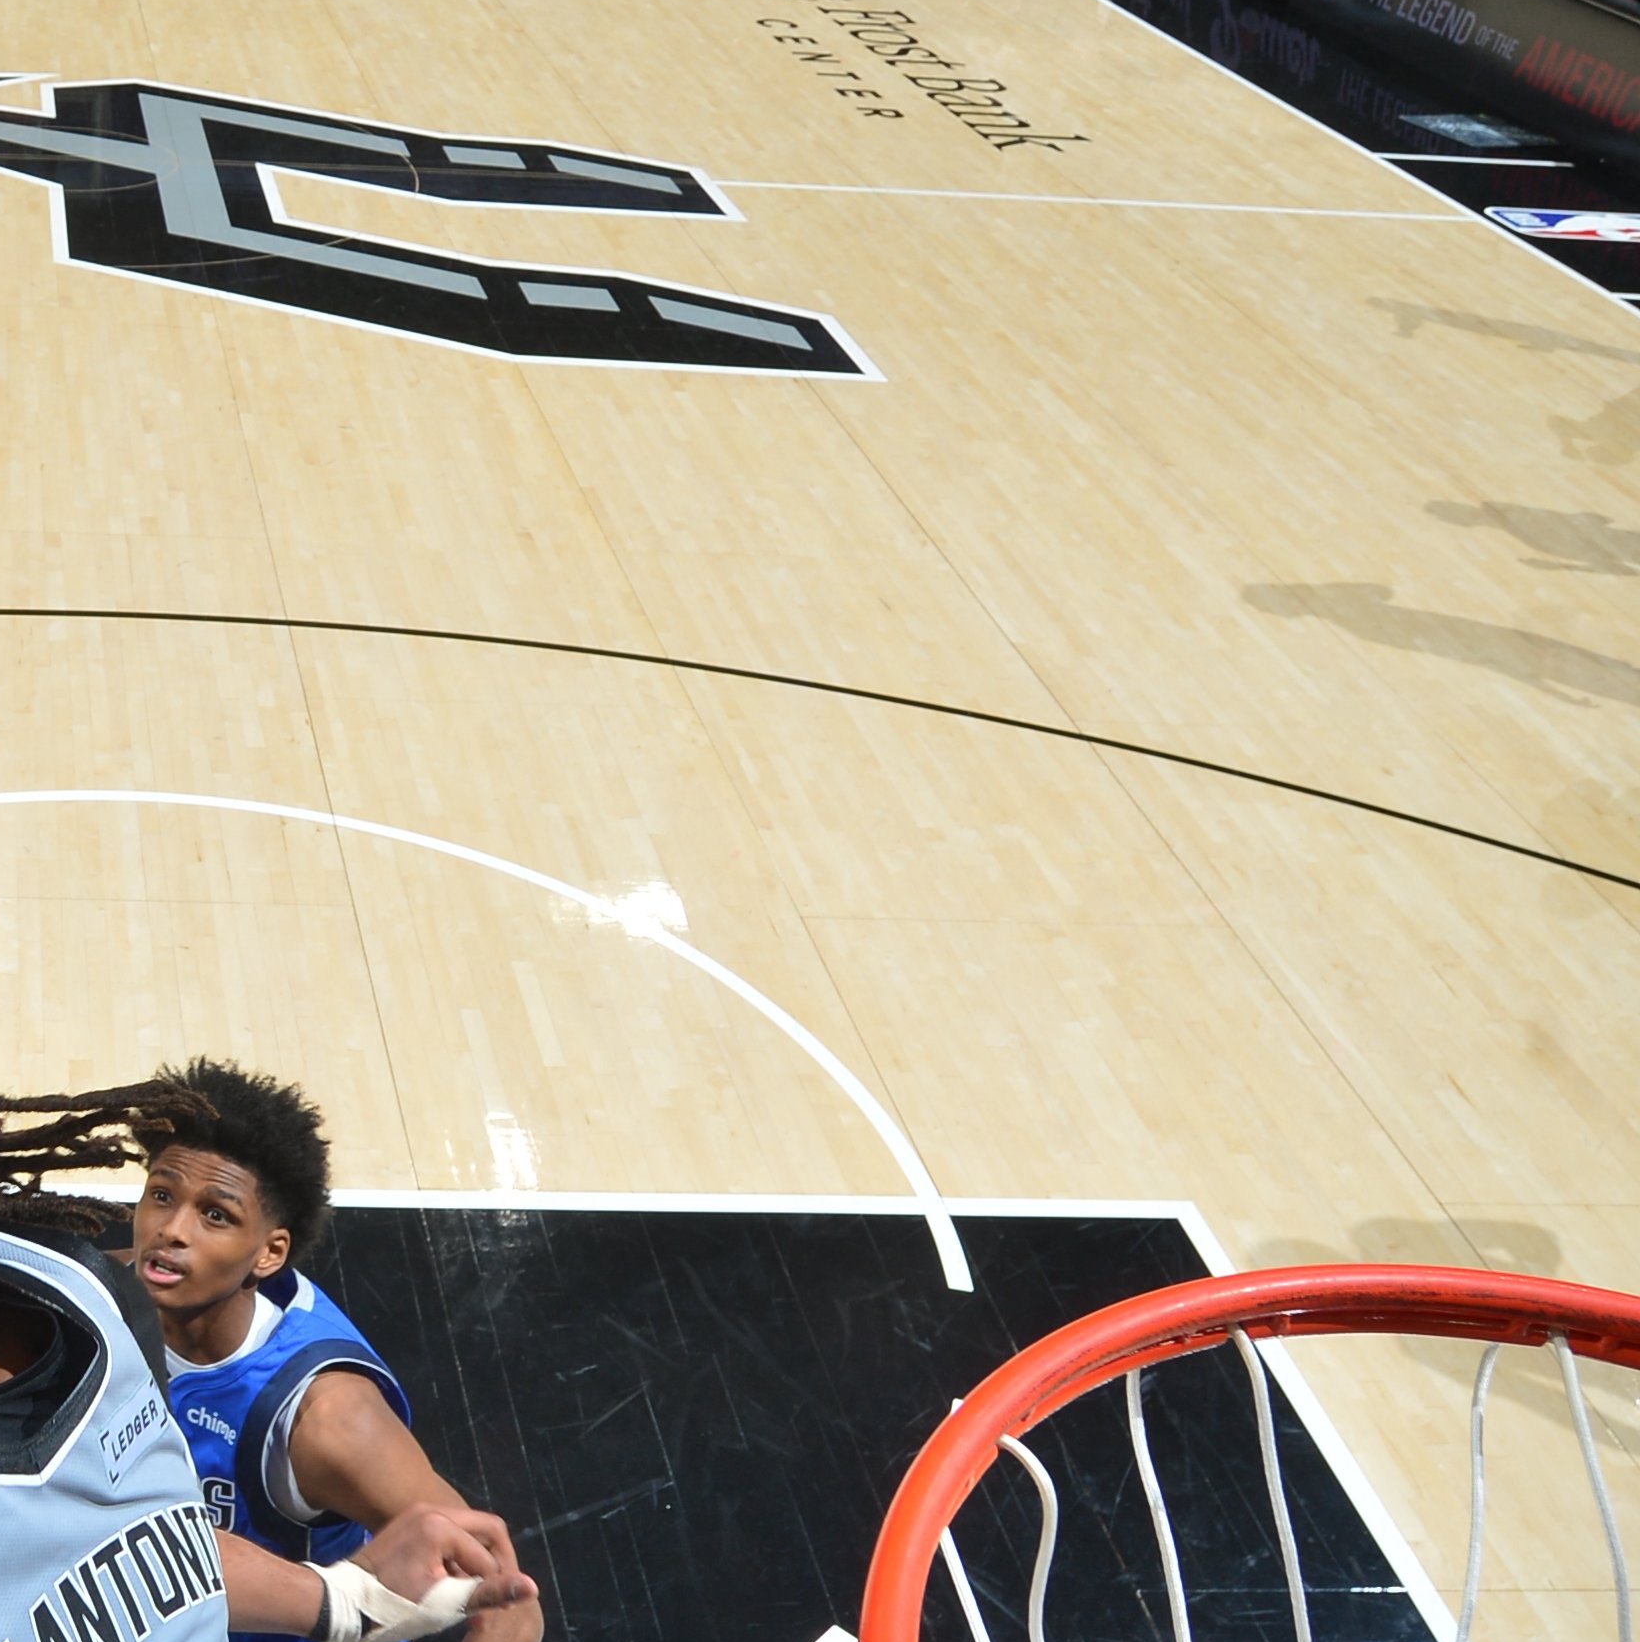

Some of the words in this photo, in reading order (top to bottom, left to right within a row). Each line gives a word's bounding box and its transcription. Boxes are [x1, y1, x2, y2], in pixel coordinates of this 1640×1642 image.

[755, 17, 905, 120] CENTER
[1474, 25, 1494, 48] OF
[1493, 33, 1520, 61] THE
[817, 6, 966, 70] Frost
[903, 72, 1093, 153] Bank
[111, 1398, 159, 1463] LEDGER
[185, 1405, 238, 1447] chime
